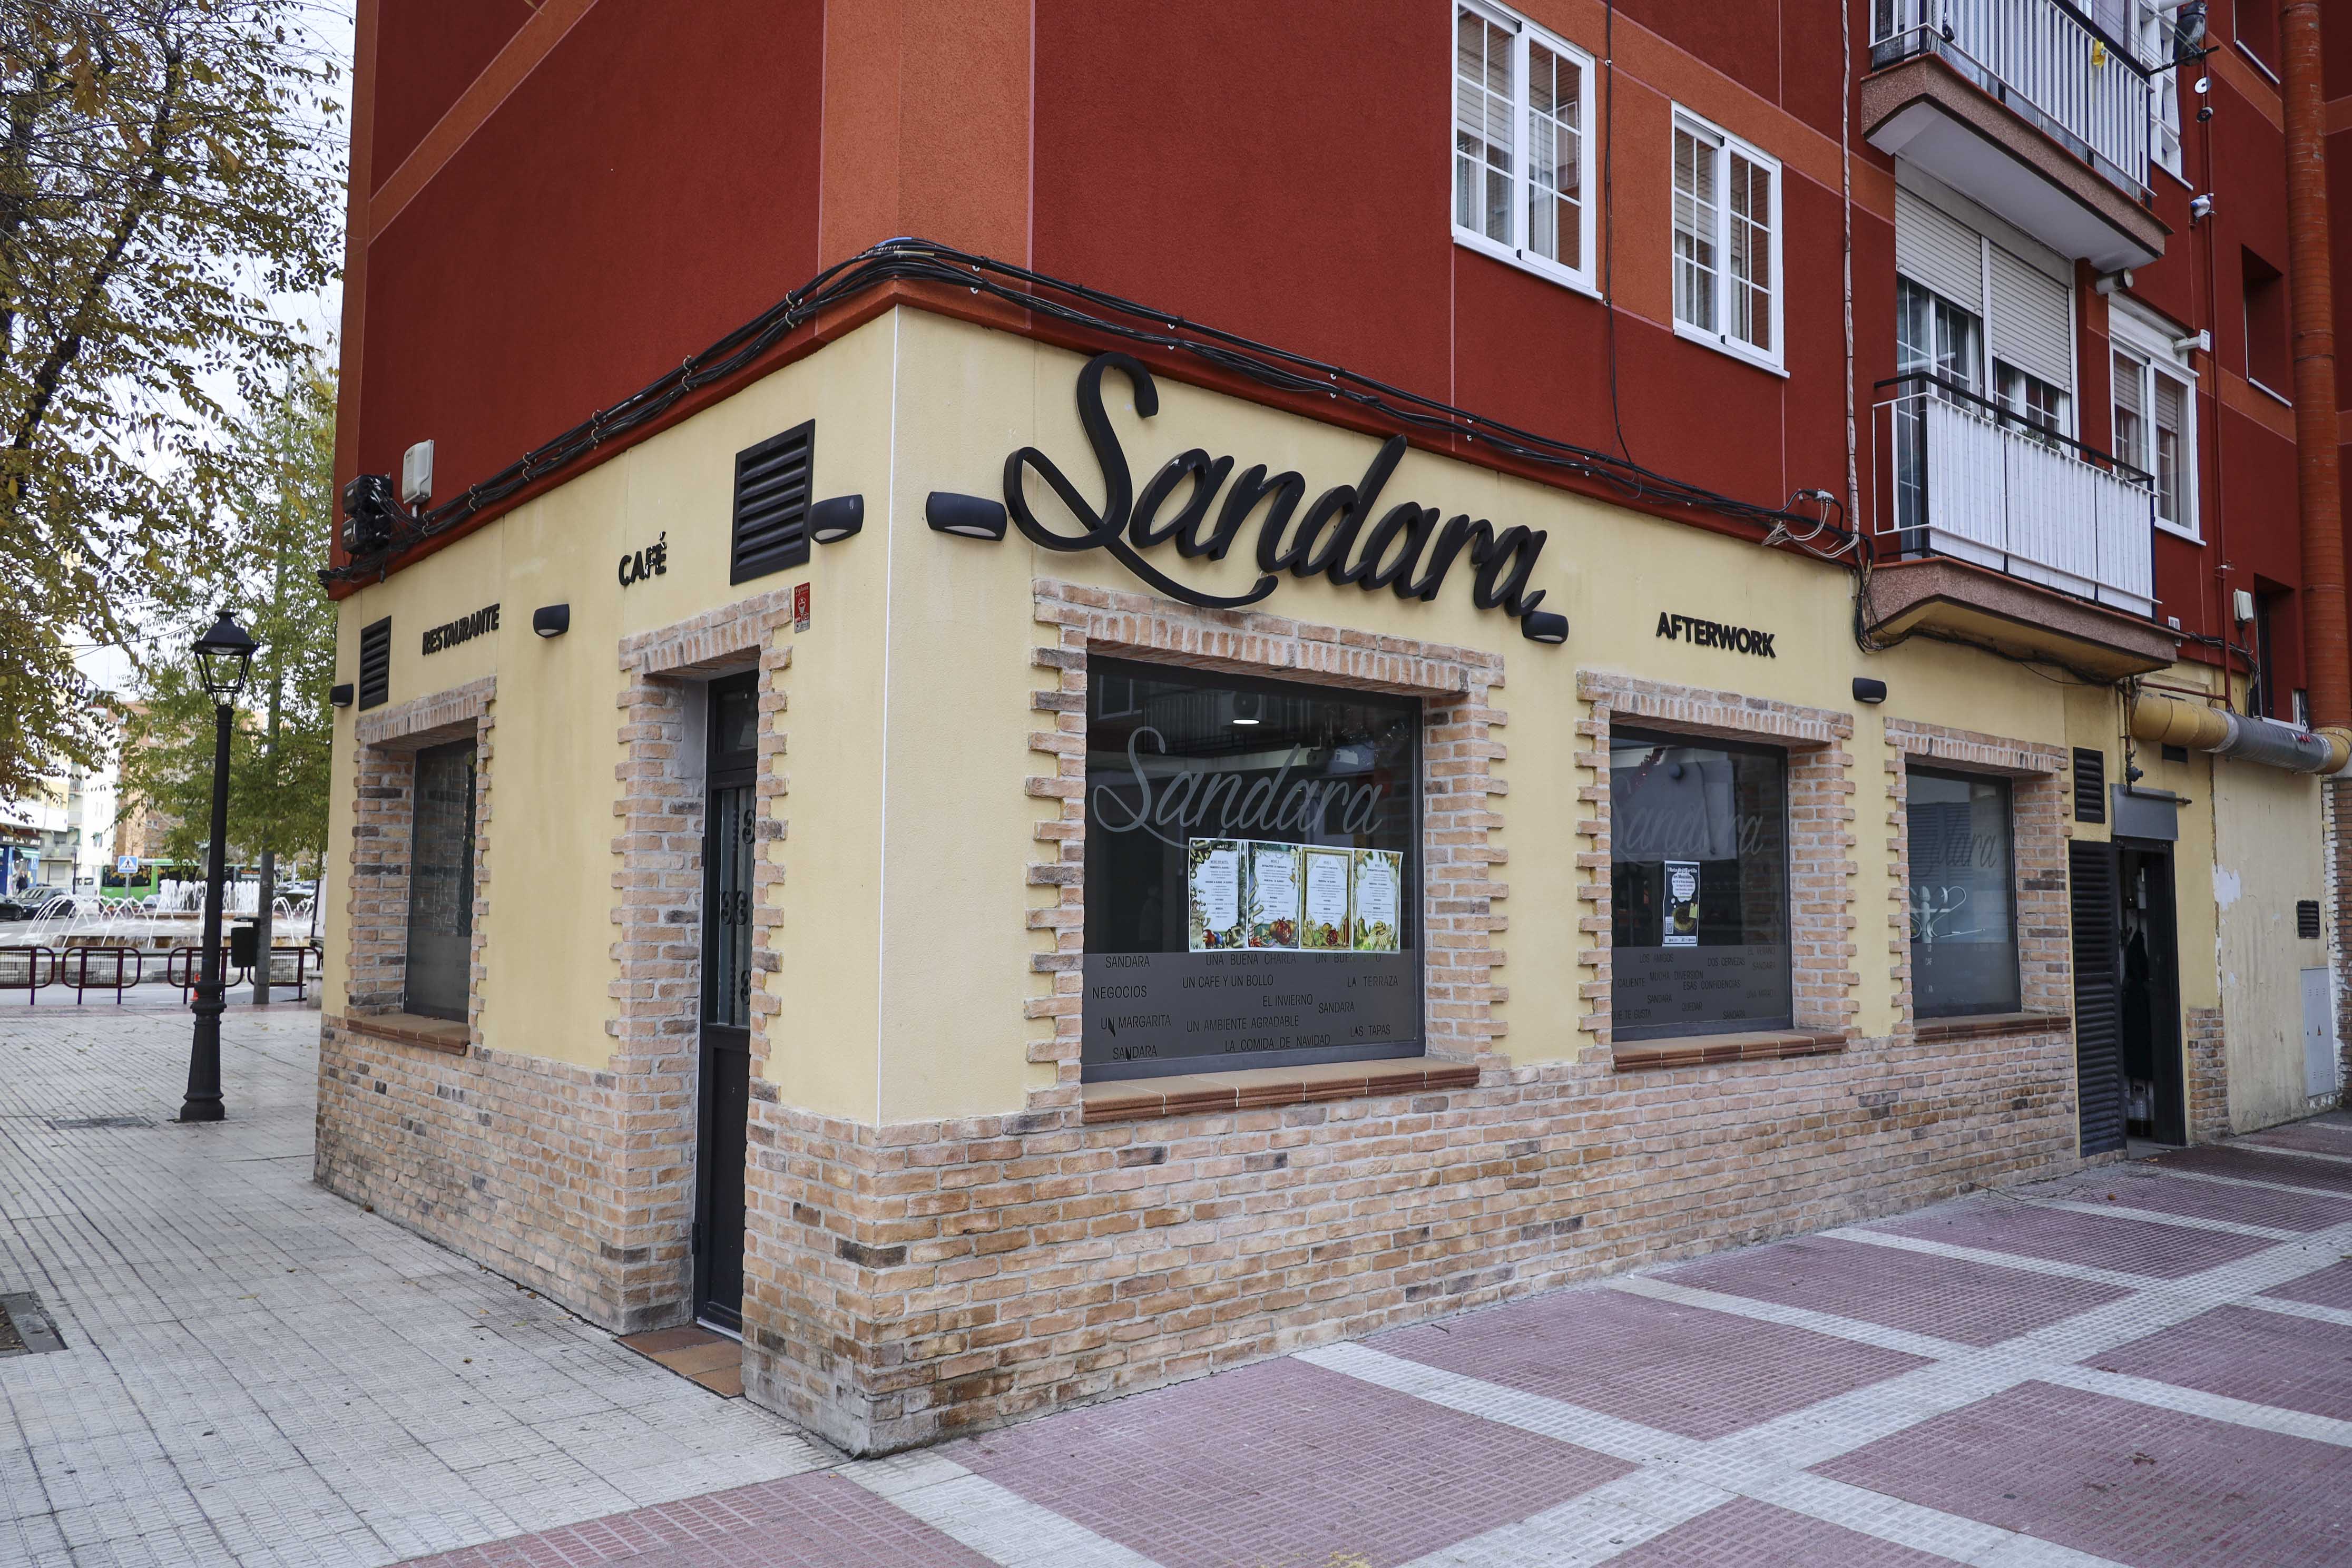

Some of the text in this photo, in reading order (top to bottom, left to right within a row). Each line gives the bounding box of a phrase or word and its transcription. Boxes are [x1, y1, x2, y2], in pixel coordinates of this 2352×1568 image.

[1003, 352, 1546, 616] Sandara
[619, 531, 667, 586] CAFÉ
[422, 603, 500, 655] RESTAURANTE
[1656, 612, 1776, 658] AFTERWORK
[1093, 726, 1383, 849] Sandara
[1611, 775, 1763, 867] Sandra
[1105, 956, 1150, 968] SANDARA
[1206, 953, 1296, 965] UNA BUENA CHARLA
[1316, 953, 1327, 963] UN
[1708, 957, 1745, 966] DOS CERVEZAS
[1183, 975, 1273, 988] UN CAFE Y UN BOLLO
[1348, 975, 1398, 987] LA TERRAZA
[1619, 978, 1645, 988] CALIENTE
[1683, 979, 1741, 991] ESAS CONFIDENCIAS
[1093, 986, 1147, 999] NEGOCIOS
[1263, 994, 1313, 1007] EL INVIERNO
[1648, 995, 1673, 1004] SANDARA
[1319, 1002, 1355, 1014] SANDARA
[1119, 1015, 1171, 1028] MARGARITA
[1187, 1015, 1299, 1032] UN AMBIENTE AGRADABLE
[1350, 1024, 1390, 1037] LAS TAPAS
[1226, 1034, 1330, 1052] LA COMIDA DE NAVIDAD
[1113, 1045, 1157, 1060] SANDARA
